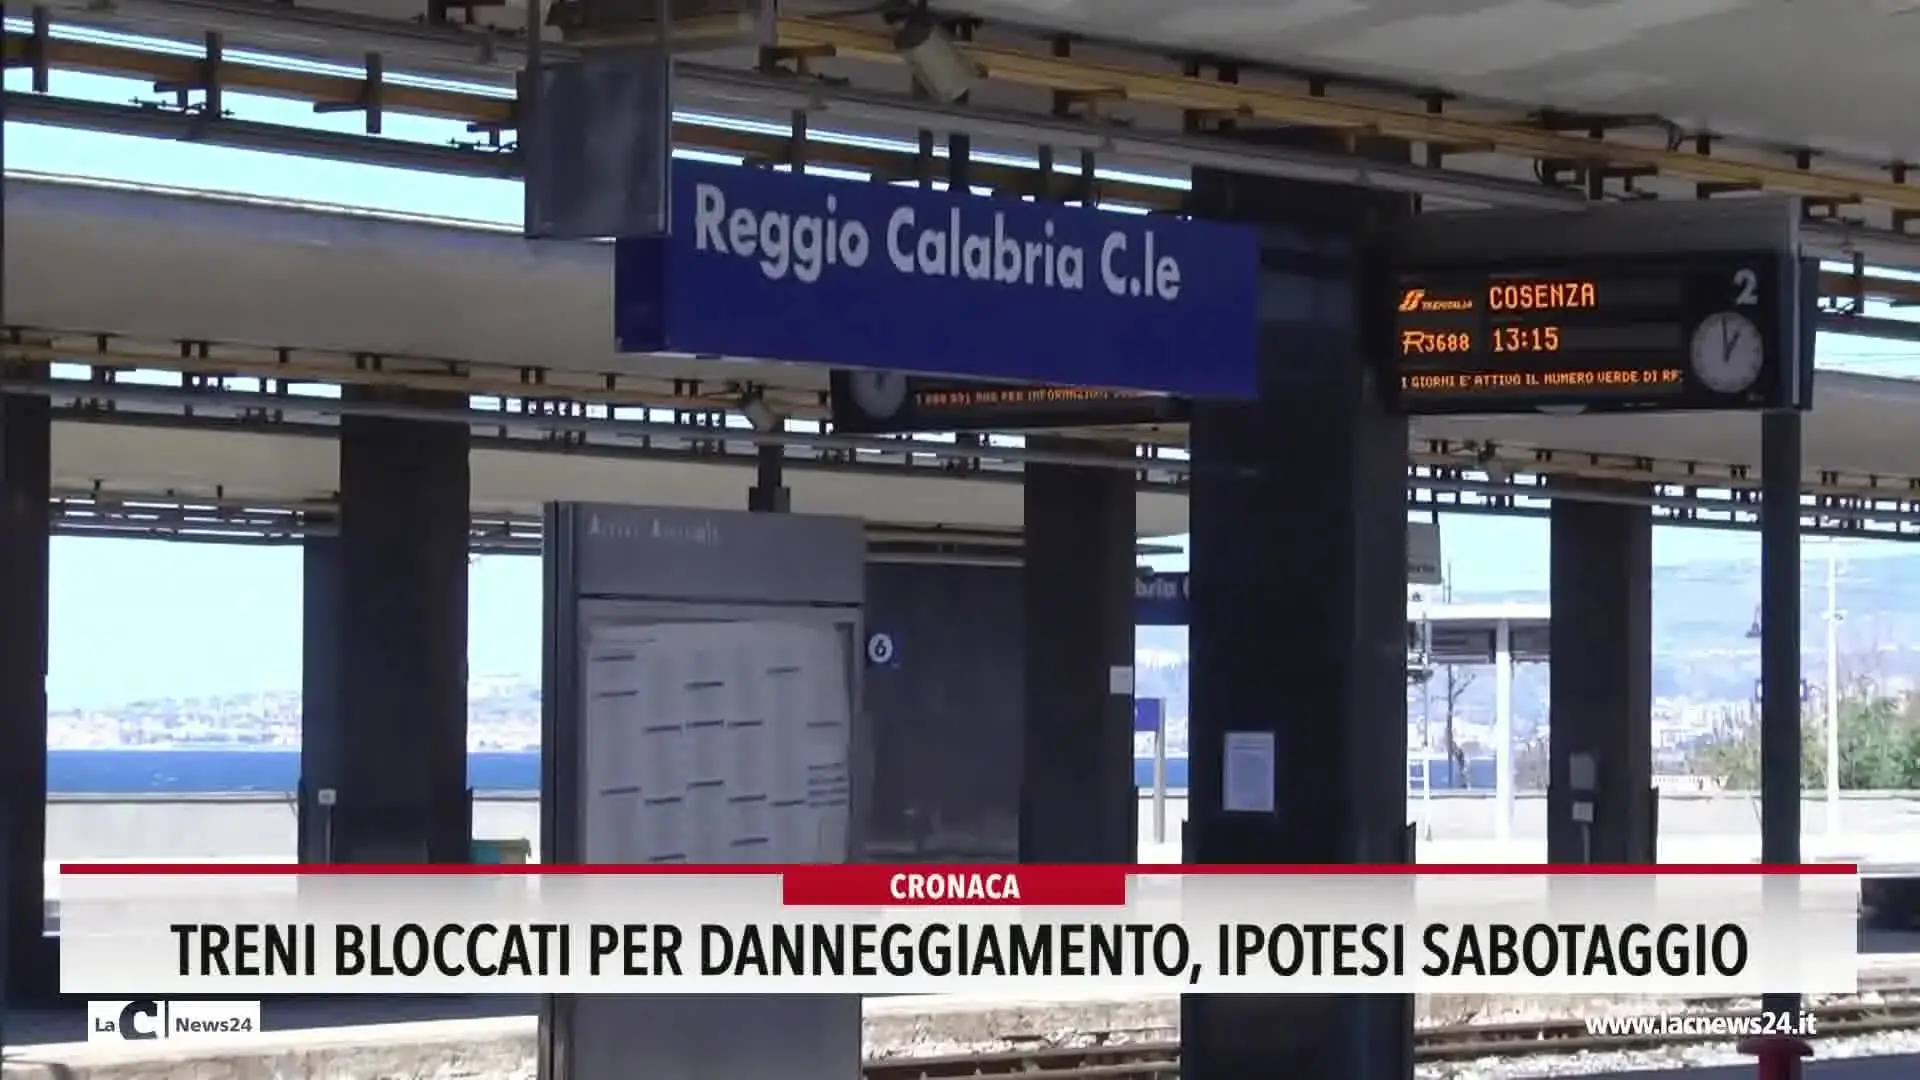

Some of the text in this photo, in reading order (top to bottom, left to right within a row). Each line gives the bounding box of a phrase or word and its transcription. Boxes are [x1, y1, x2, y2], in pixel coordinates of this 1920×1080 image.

[695, 183, 1182, 301] Reggio Calabria C.le
[1489, 282, 1596, 310] COSENZA
[1734, 270, 1758, 305] 2
[1494, 326, 1559, 352] 13:15
[1411, 375, 1455, 389] GIORNI
[1474, 373, 1521, 386] ATTIVO
[1525, 373, 1539, 385] IL
[1543, 371, 1594, 385] NUMERO
[1597, 370, 1639, 384] VERDE
[1643, 369, 1658, 383] DI
